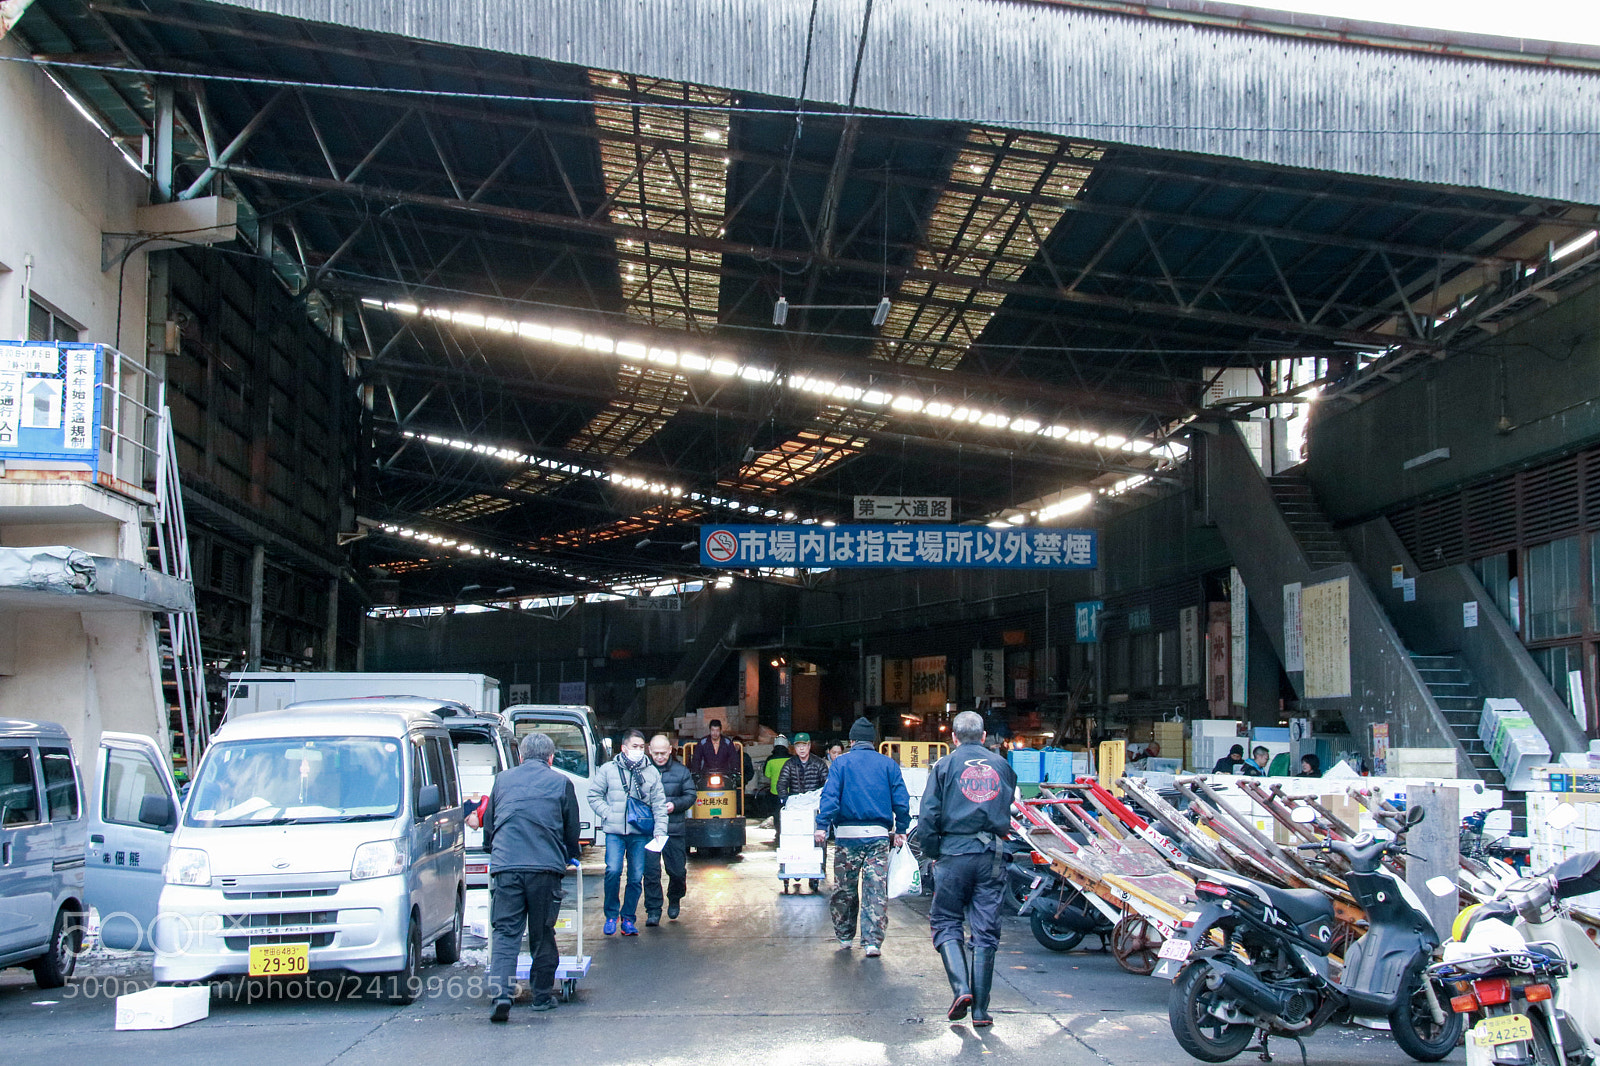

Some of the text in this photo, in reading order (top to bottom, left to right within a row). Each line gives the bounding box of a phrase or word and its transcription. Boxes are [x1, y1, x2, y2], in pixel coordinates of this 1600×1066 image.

[70, 353, 88, 448] 年末年始交通規制
[857, 498, 949, 518] 第一大通路
[738, 529, 1093, 566] 市場内は指定場所以外禁煙
[262, 956, 305, 973] 29-90
[1487, 1025, 1528, 1043] 24225
